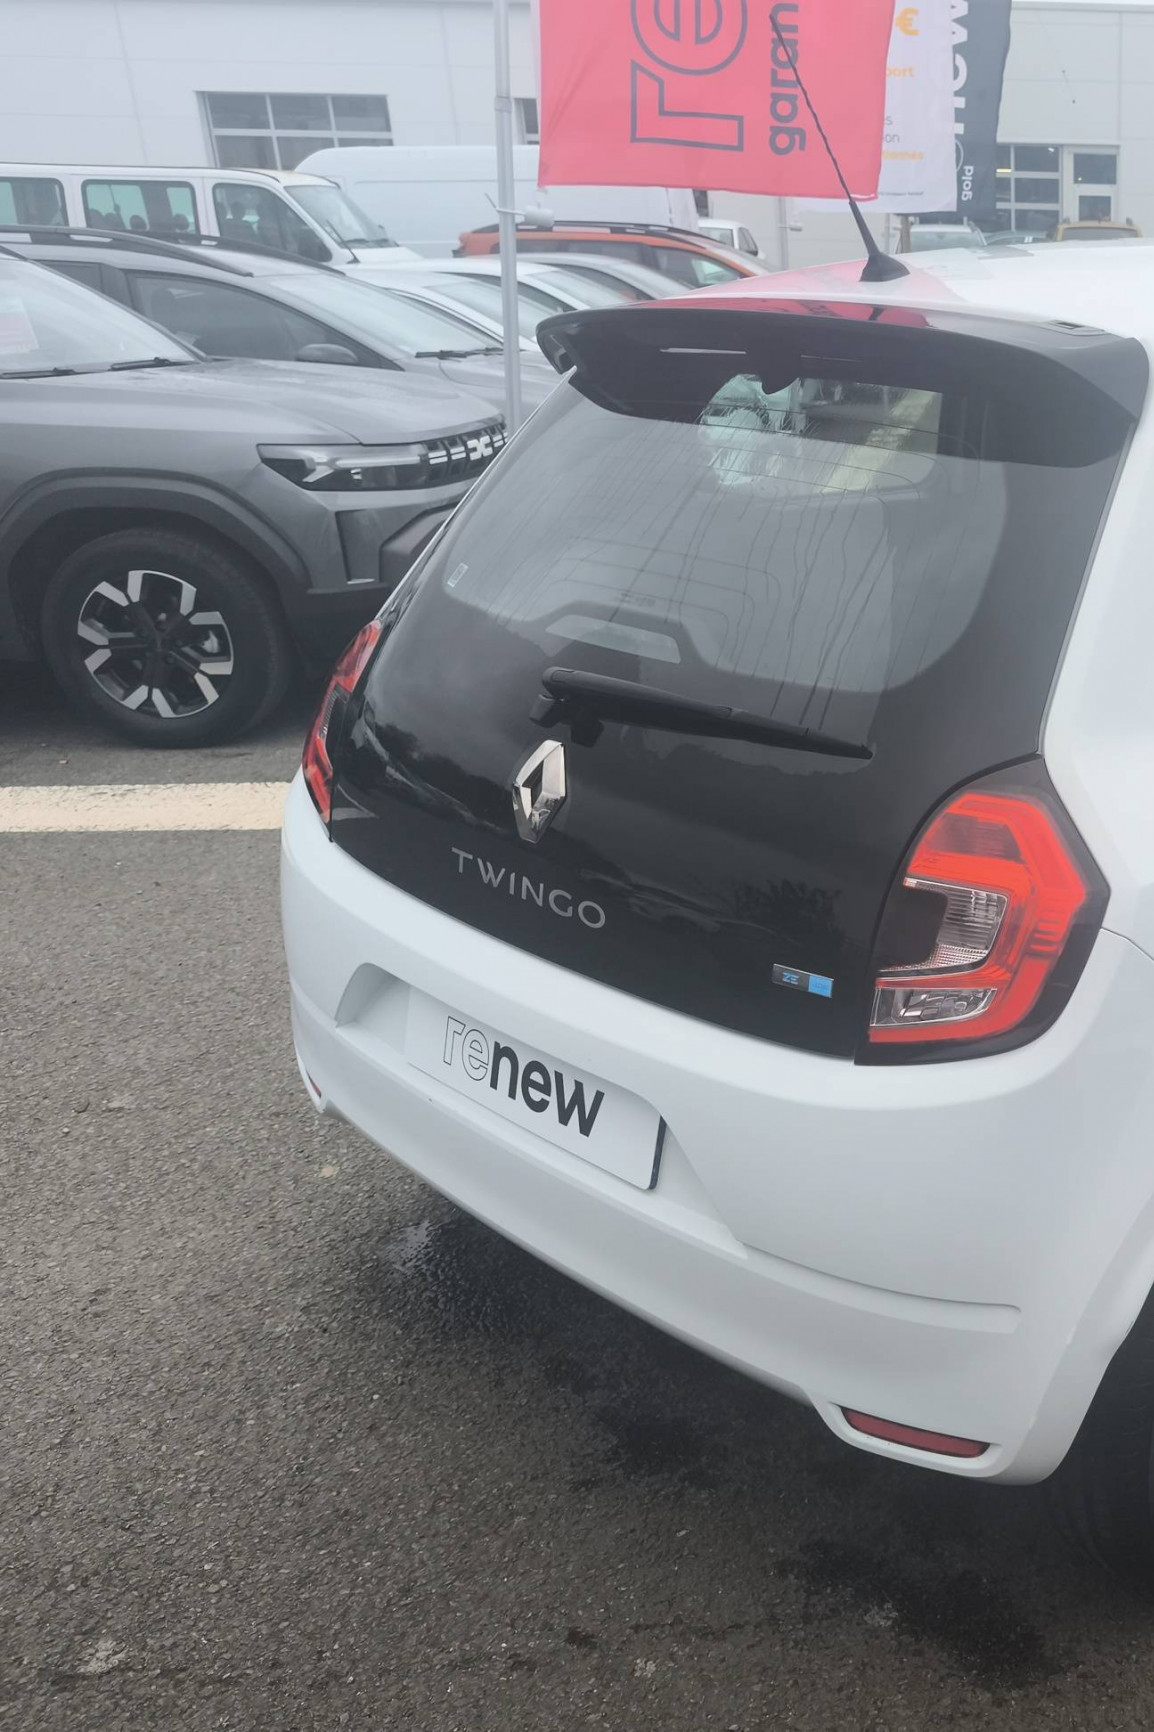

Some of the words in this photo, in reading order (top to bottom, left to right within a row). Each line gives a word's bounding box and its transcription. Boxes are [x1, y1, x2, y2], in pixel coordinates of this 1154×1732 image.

[961, 165, 974, 201] gold
[451, 847, 606, 929] TWINGO
[443, 1015, 605, 1138] renew
